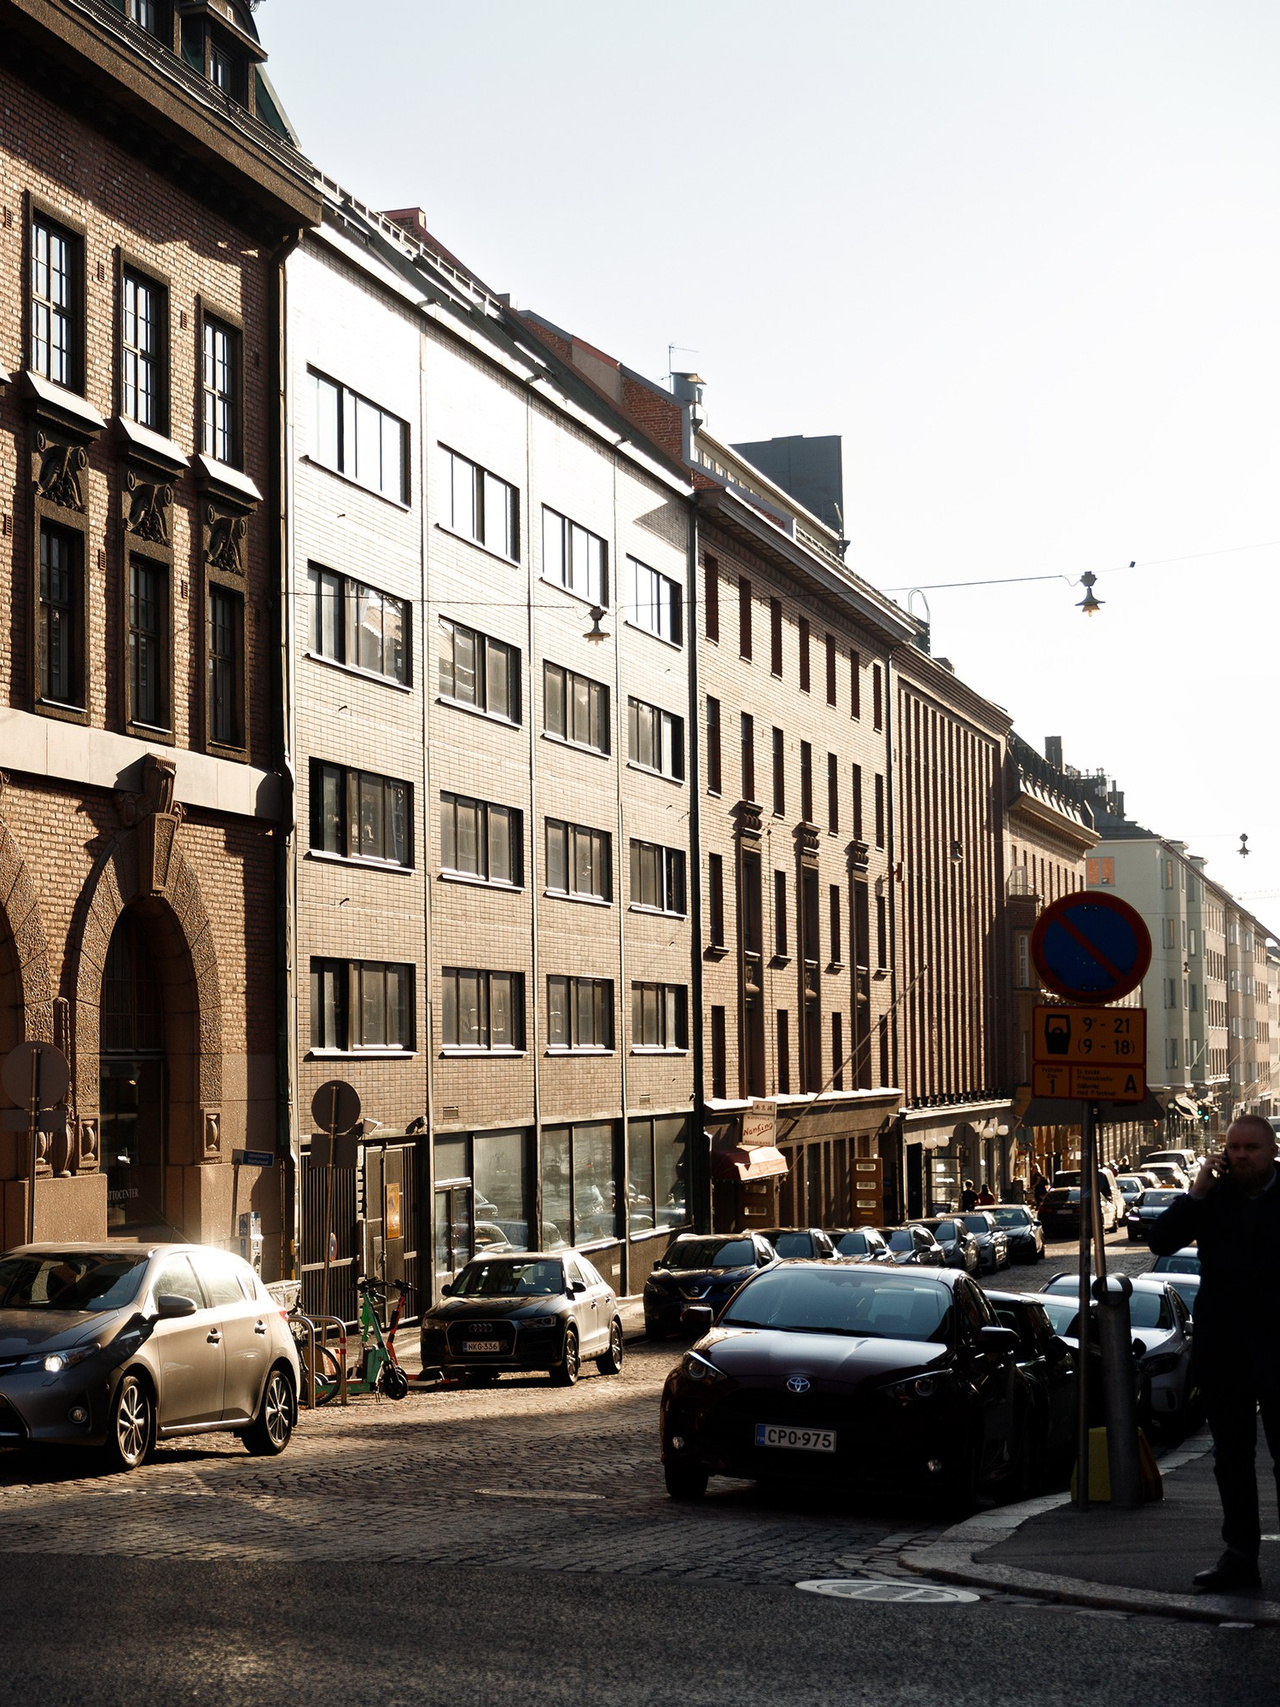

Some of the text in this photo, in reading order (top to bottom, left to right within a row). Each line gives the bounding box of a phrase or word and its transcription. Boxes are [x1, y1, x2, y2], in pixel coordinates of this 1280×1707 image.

[1114, 1018, 1130, 1033] 21
[1078, 1038, 1093, 1054] (9
[1114, 1039, 1136, 1055] 18)
[1049, 1079, 1056, 1094] 1
[1124, 1074, 1137, 1093] A
[108, 1188, 139, 1200] TTOCENTER
